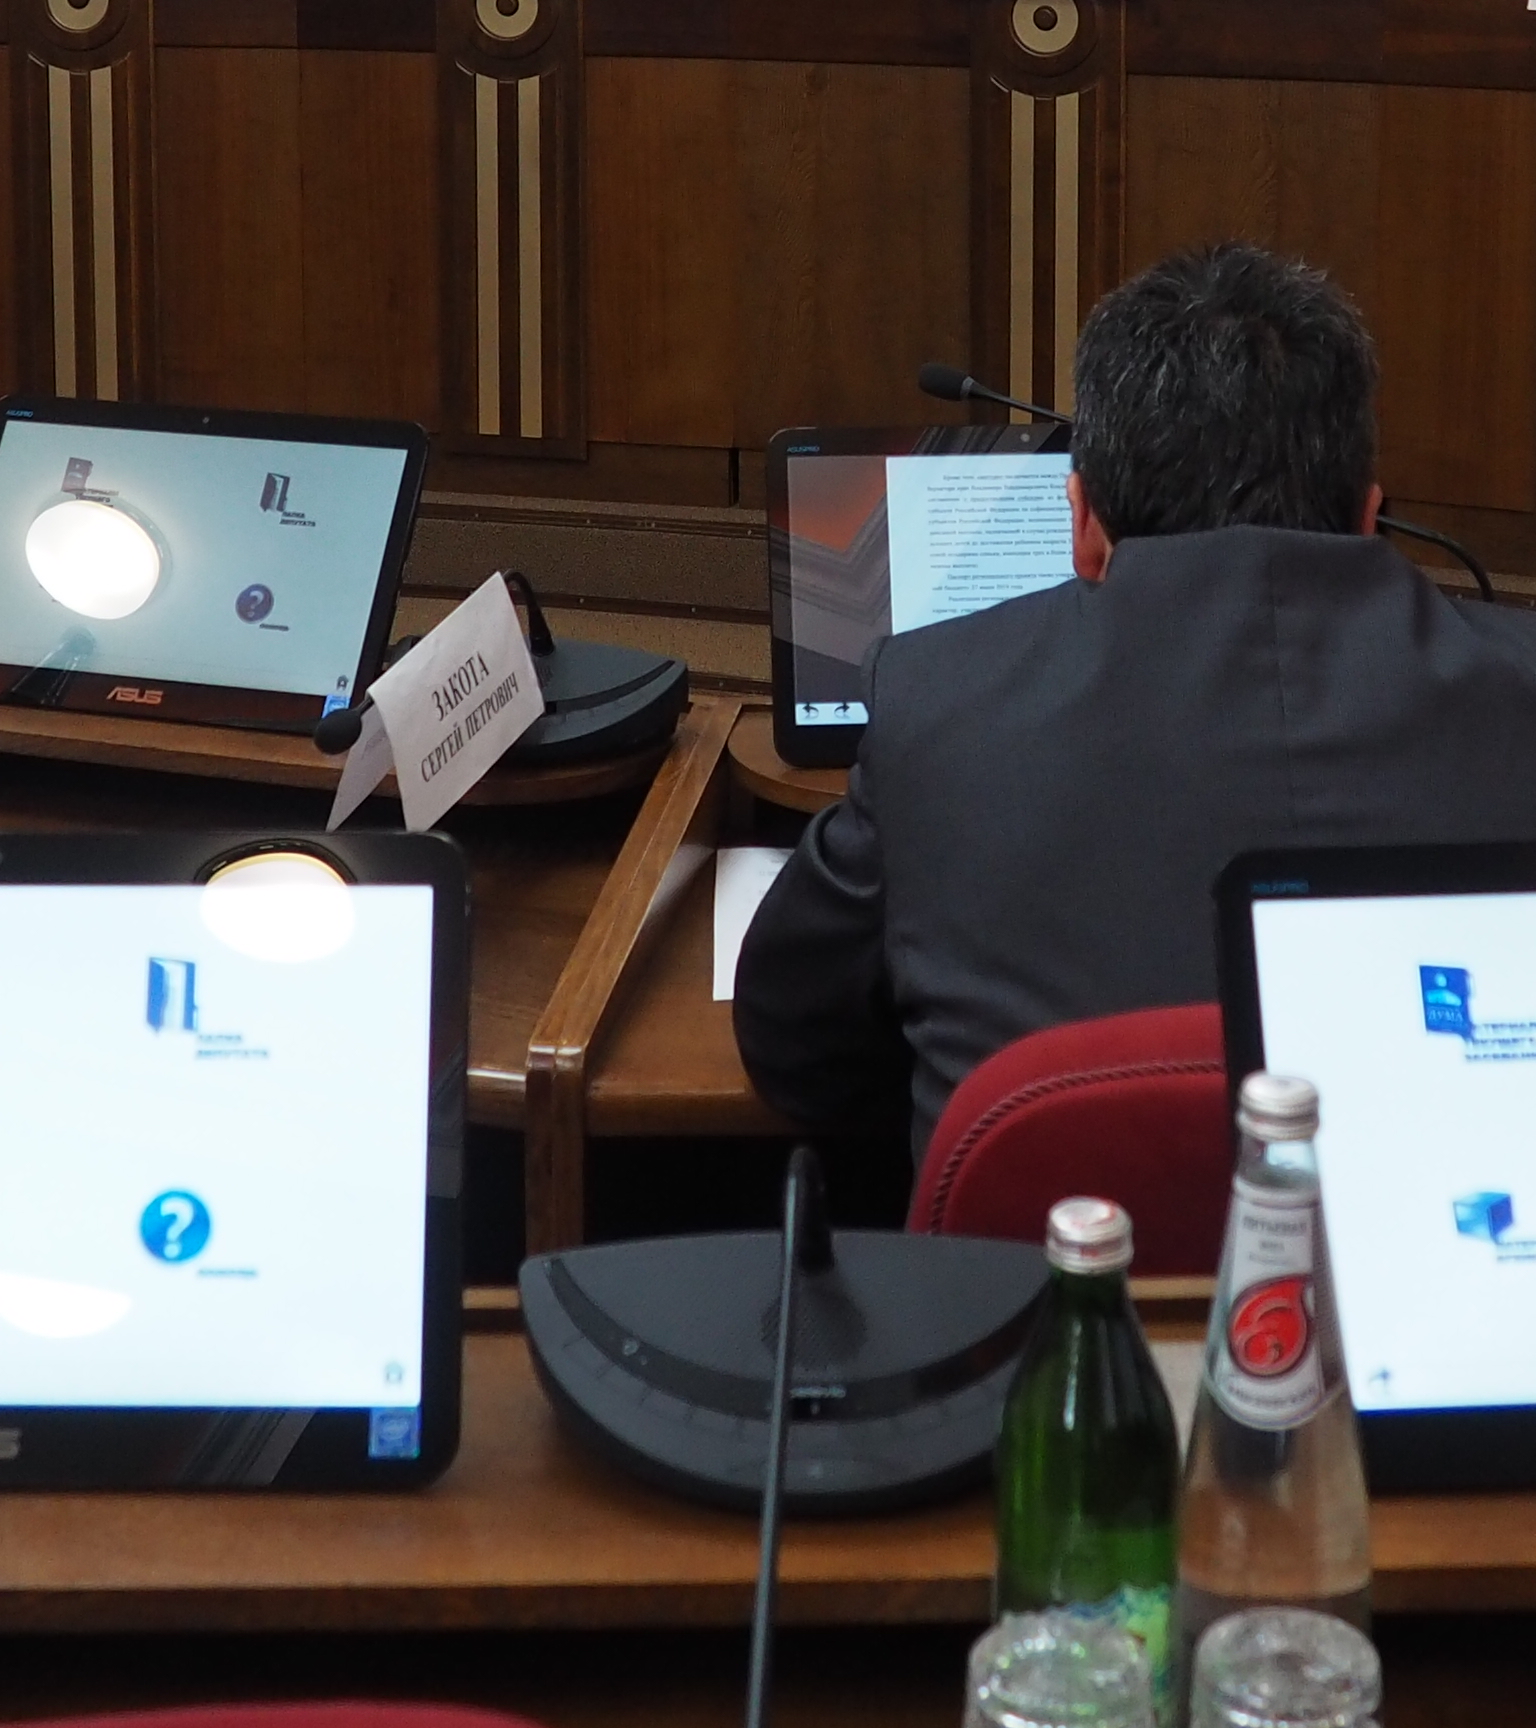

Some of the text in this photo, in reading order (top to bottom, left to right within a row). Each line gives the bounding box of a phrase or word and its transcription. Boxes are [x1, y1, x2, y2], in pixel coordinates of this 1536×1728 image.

[106, 686, 164, 705] ASUS
[431, 651, 490, 722] ЗАКОТА
[420, 672, 519, 783] СЕРГЕЙ ПЕТРОВИЧ
